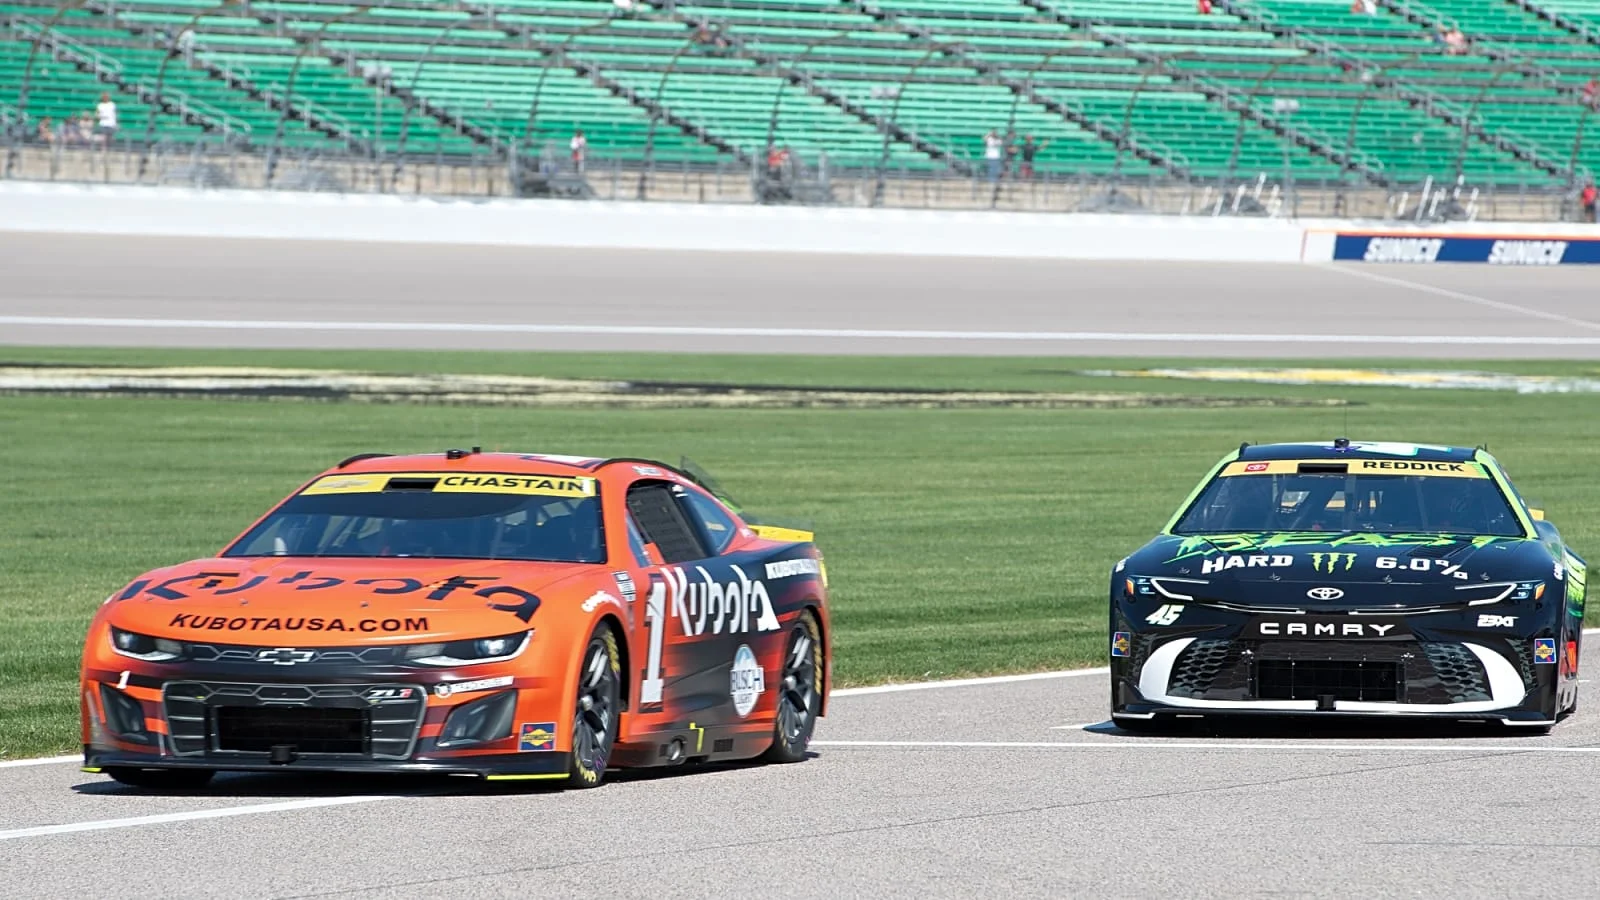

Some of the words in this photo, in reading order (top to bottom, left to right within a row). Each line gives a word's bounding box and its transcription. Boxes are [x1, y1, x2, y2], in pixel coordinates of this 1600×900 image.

[1363, 237, 1444, 263] SUNOCO
[1488, 239, 1568, 264] SUNOCO
[1362, 460, 1464, 472] REDDICK
[443, 474, 584, 492] CHASTAIN
[1201, 554, 1294, 574] HARD
[1375, 556, 1469, 580] 6.0%
[659, 564, 781, 637] Kubota
[169, 613, 429, 632] KUBOTAUSA.COM
[1145, 604, 1185, 626] 45
[1259, 621, 1395, 636] CAMRY
[639, 582, 666, 703] 1
[116, 670, 131, 690] 1
[731, 669, 763, 692] BUSCH
